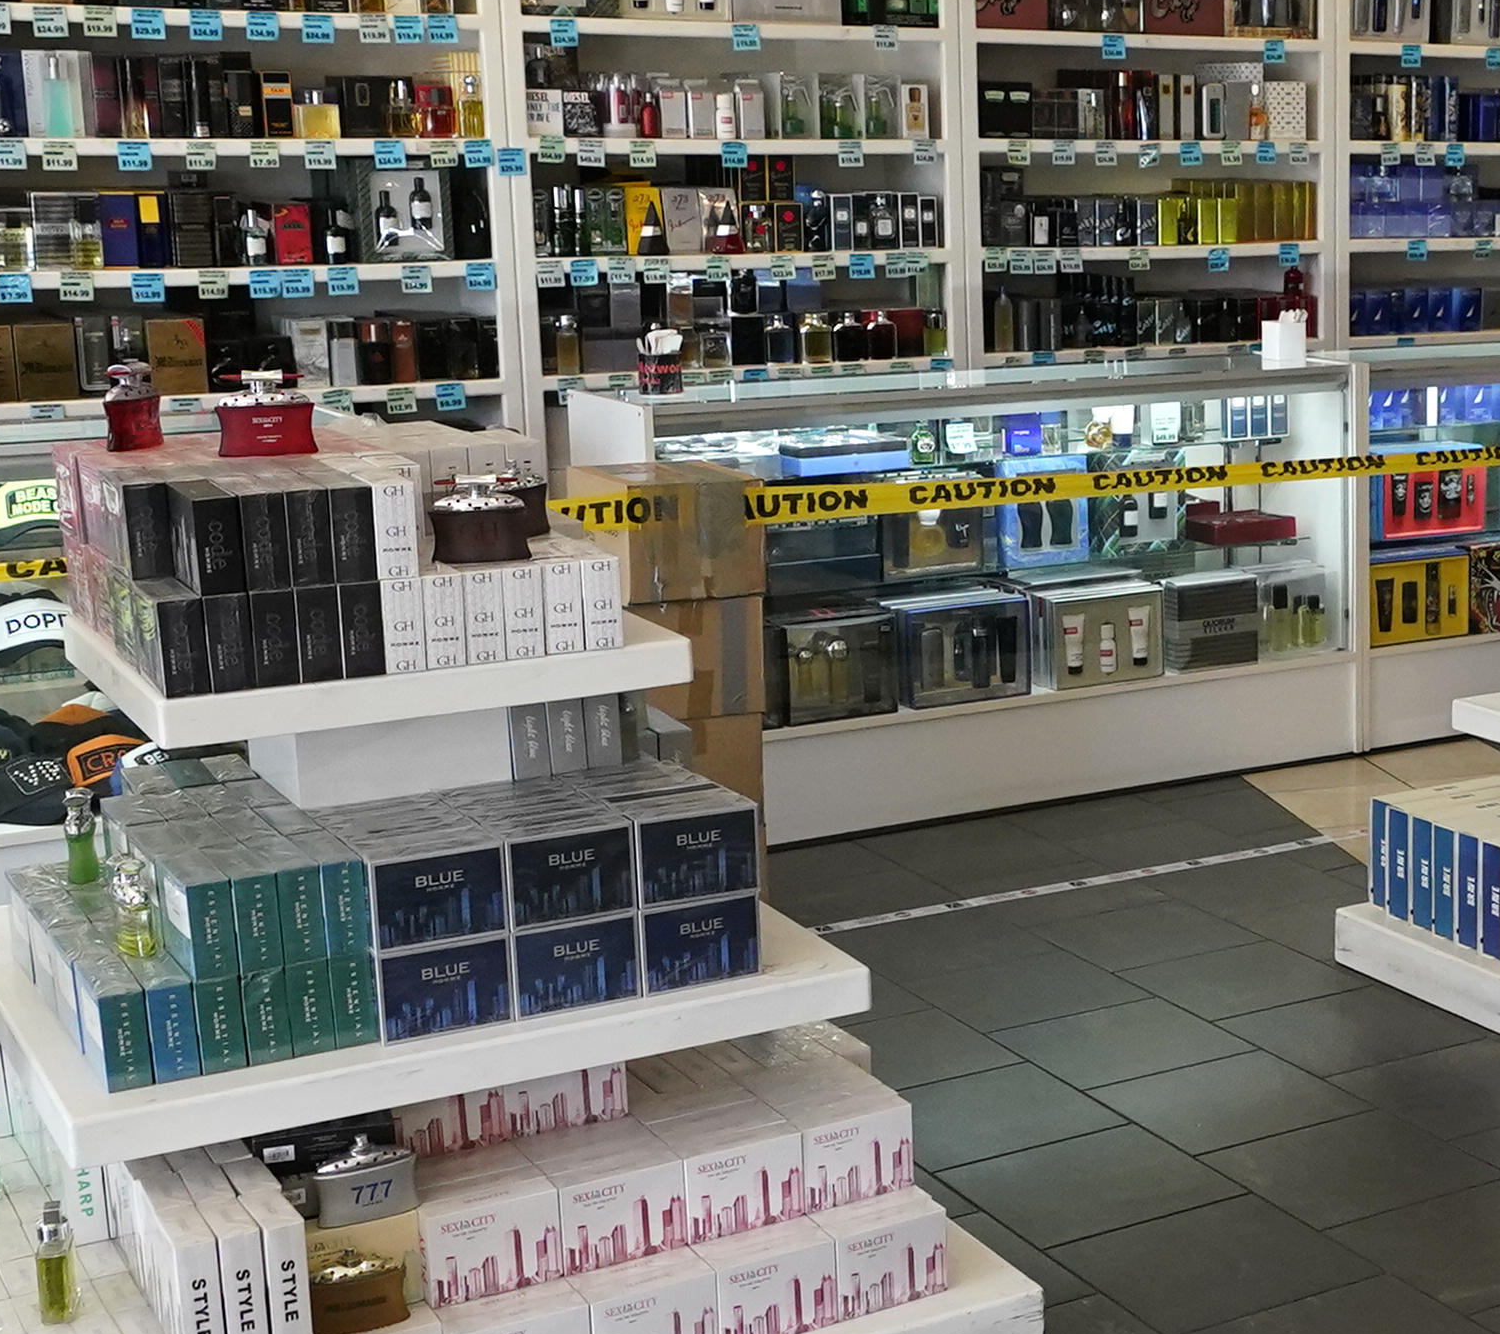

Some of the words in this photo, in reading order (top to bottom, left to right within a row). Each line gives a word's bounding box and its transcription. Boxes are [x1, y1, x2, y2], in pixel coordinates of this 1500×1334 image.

[1260, 454, 1387, 478] CAUTION
[1092, 464, 1229, 491] CAUTION
[15, 487, 57, 504] BEAS
[908, 476, 1058, 506] CAUTION
[11, 500, 51, 517] MODE
[560, 494, 680, 528] UTION
[594, 599, 613, 611] GH
[596, 637, 615, 648] GH
[415, 869, 464, 890] BLUE
[553, 939, 600, 959] BLUE
[421, 961, 471, 982] BLUE
[75, 1167, 95, 1219] HARP
[351, 1179, 394, 1205] 777
[281, 1259, 299, 1323] STYLE
